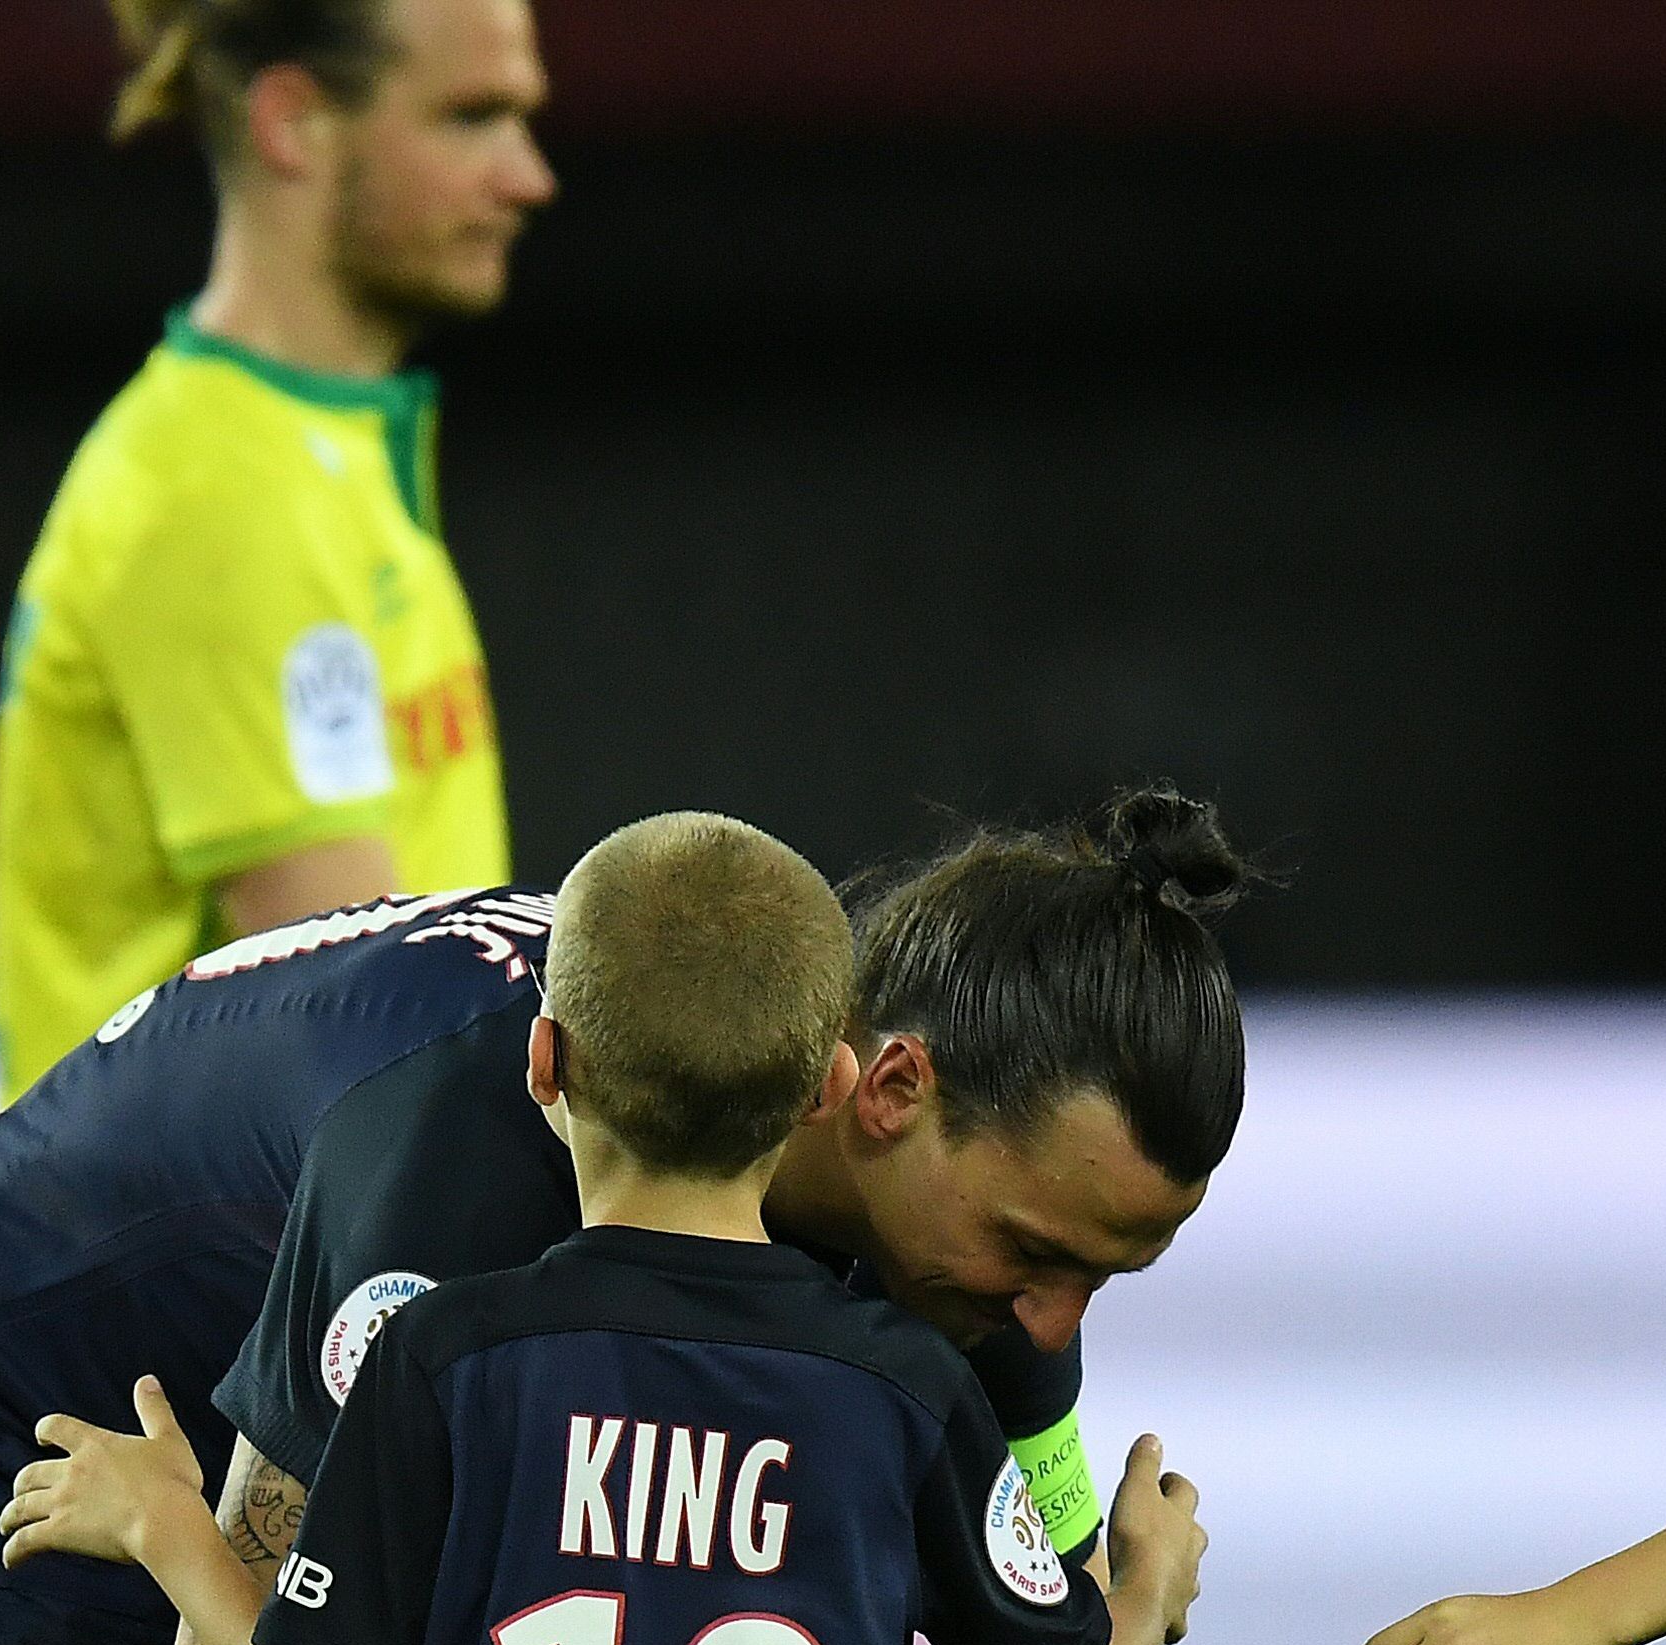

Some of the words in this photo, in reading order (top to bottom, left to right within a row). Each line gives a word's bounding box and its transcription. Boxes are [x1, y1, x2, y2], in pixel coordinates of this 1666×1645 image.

[328, 1320, 348, 1367] PARIS
[558, 1414, 794, 1577] KING
[1004, 1561, 1036, 1595] PARIS
